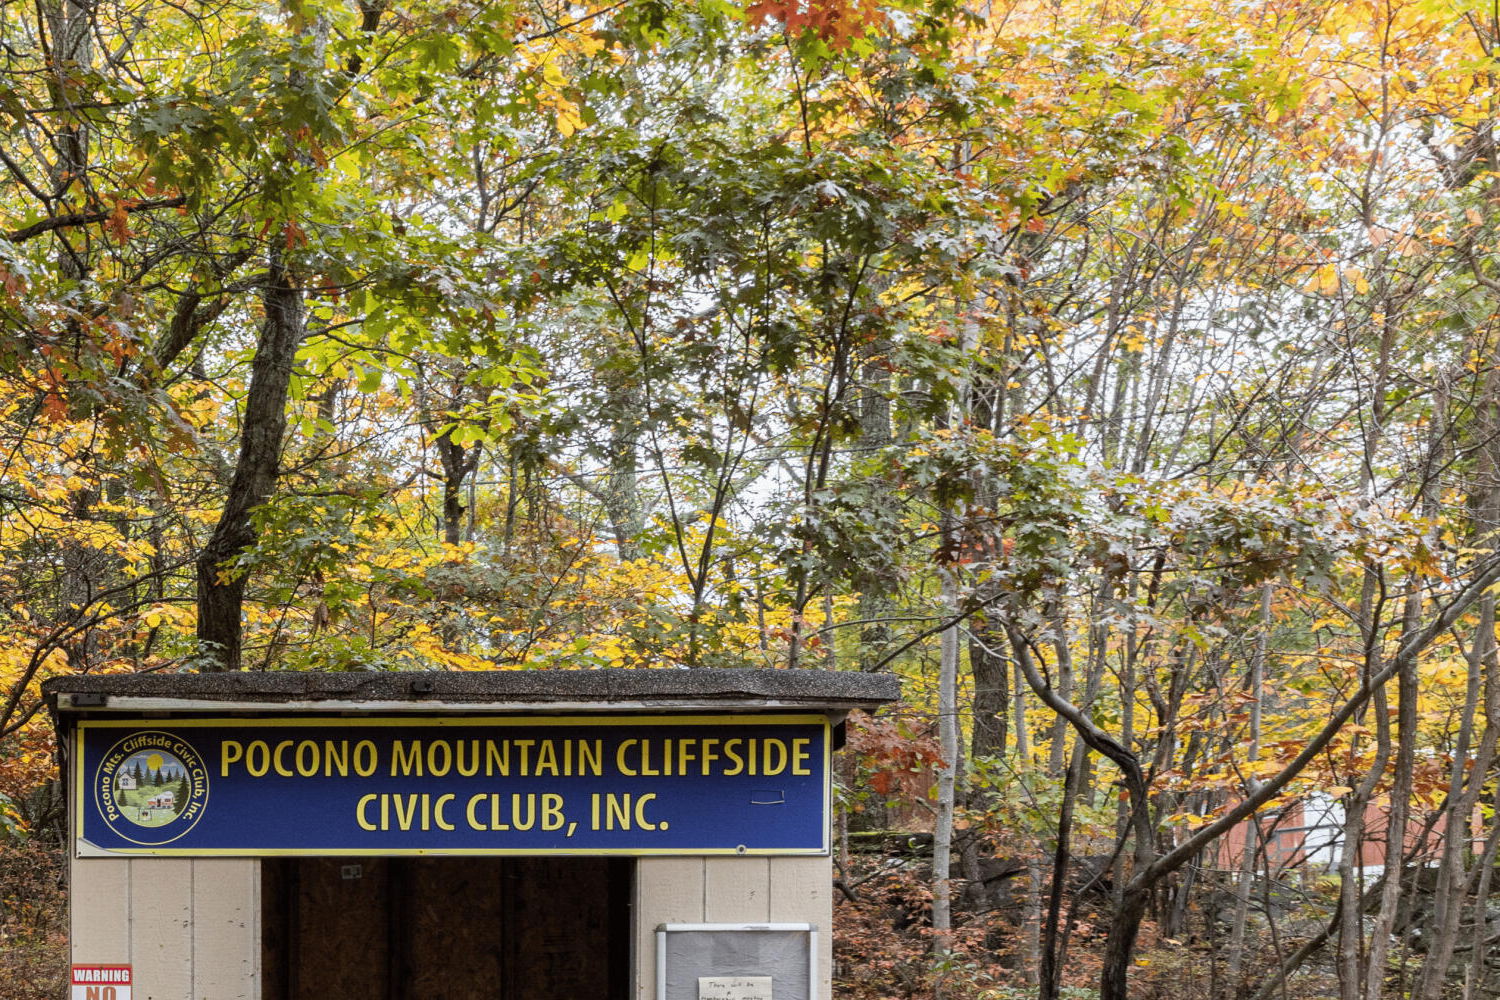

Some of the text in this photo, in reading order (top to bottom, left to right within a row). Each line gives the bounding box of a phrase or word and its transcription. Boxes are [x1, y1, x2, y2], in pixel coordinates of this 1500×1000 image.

[102, 735, 206, 822] Pocono Mts. Cliffside Civic Club, Inc.
[220, 737, 812, 778] POCONO MOUNTAIN CLIFFSIDE
[355, 792, 670, 838] CIVIC CLUB, INC.
[73, 969, 130, 982] WARNING
